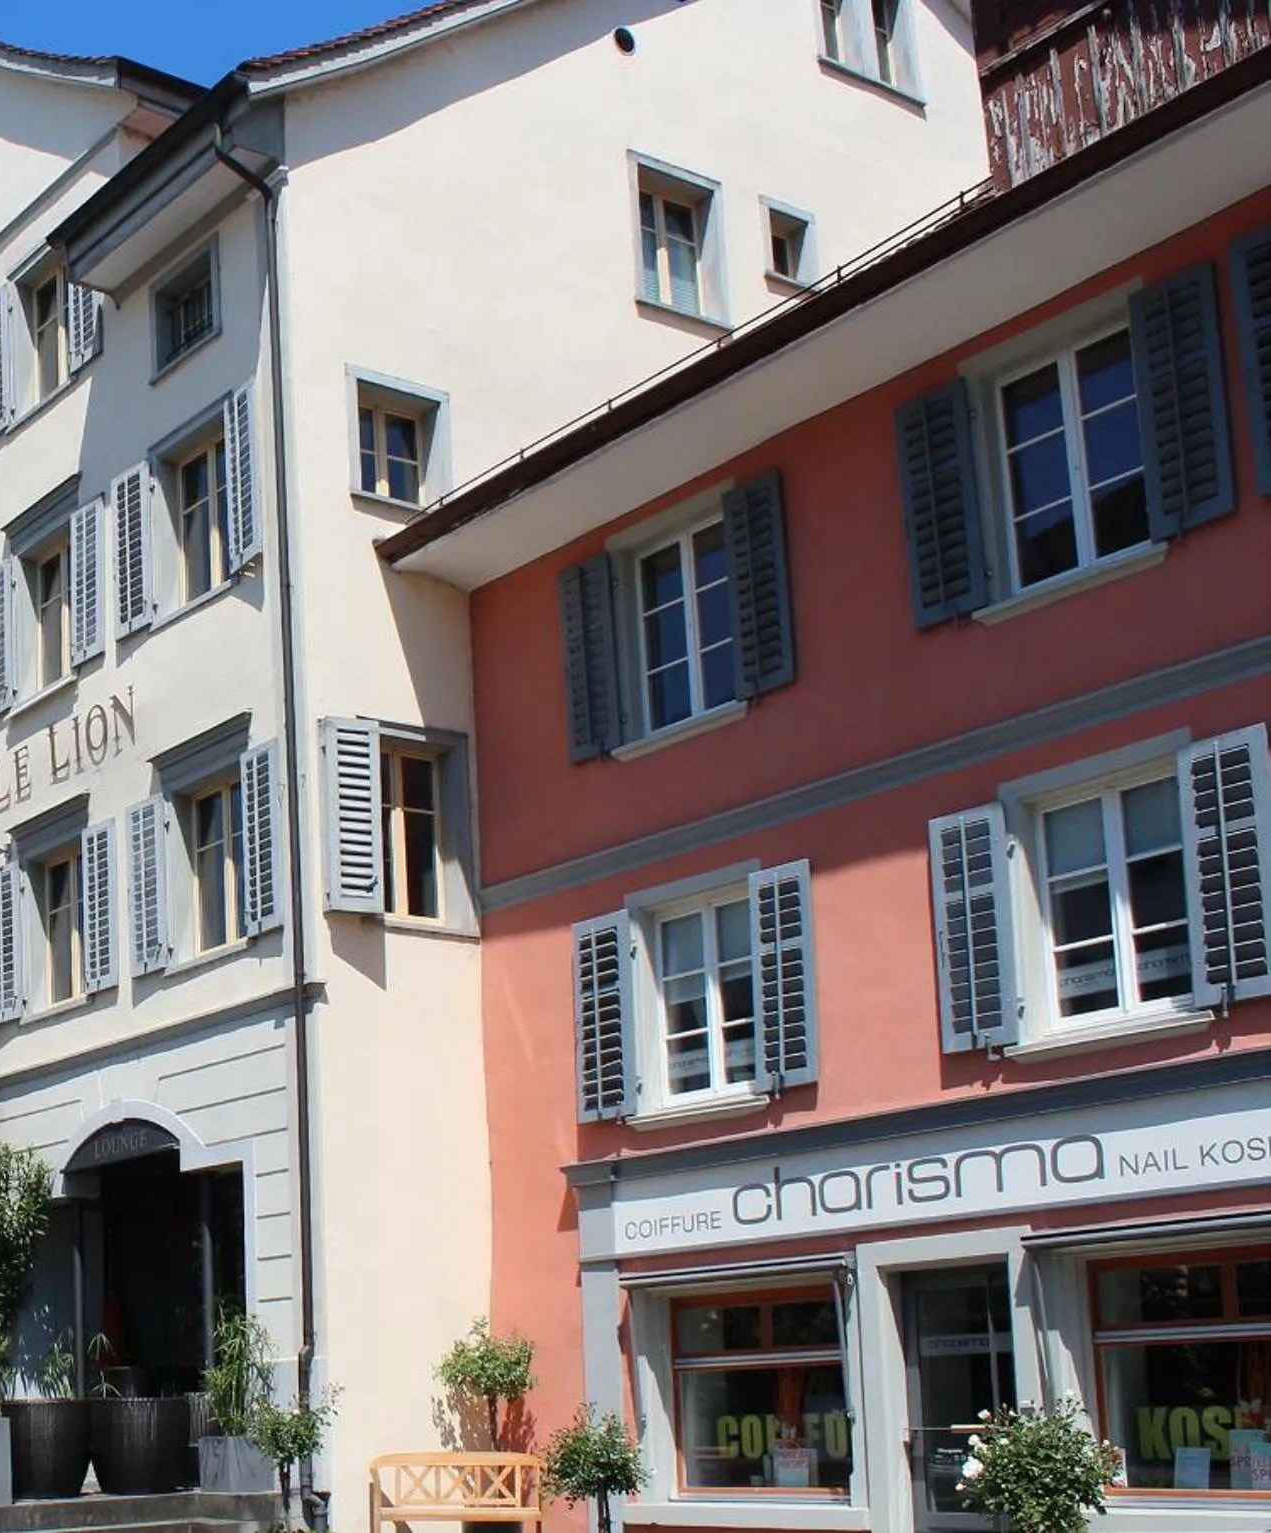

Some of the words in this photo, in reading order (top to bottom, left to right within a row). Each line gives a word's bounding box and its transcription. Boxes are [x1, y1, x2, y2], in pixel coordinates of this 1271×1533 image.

[47, 685, 137, 785] LION
[93, 1132, 148, 1159] LOUNGE
[625, 1210, 722, 1241] COIFFURE
[732, 1133, 1105, 1226] charisma
[1118, 1148, 1189, 1177] NAIL
[1199, 1136, 1271, 1167] KOS
[1135, 1404, 1242, 1461] KOS
